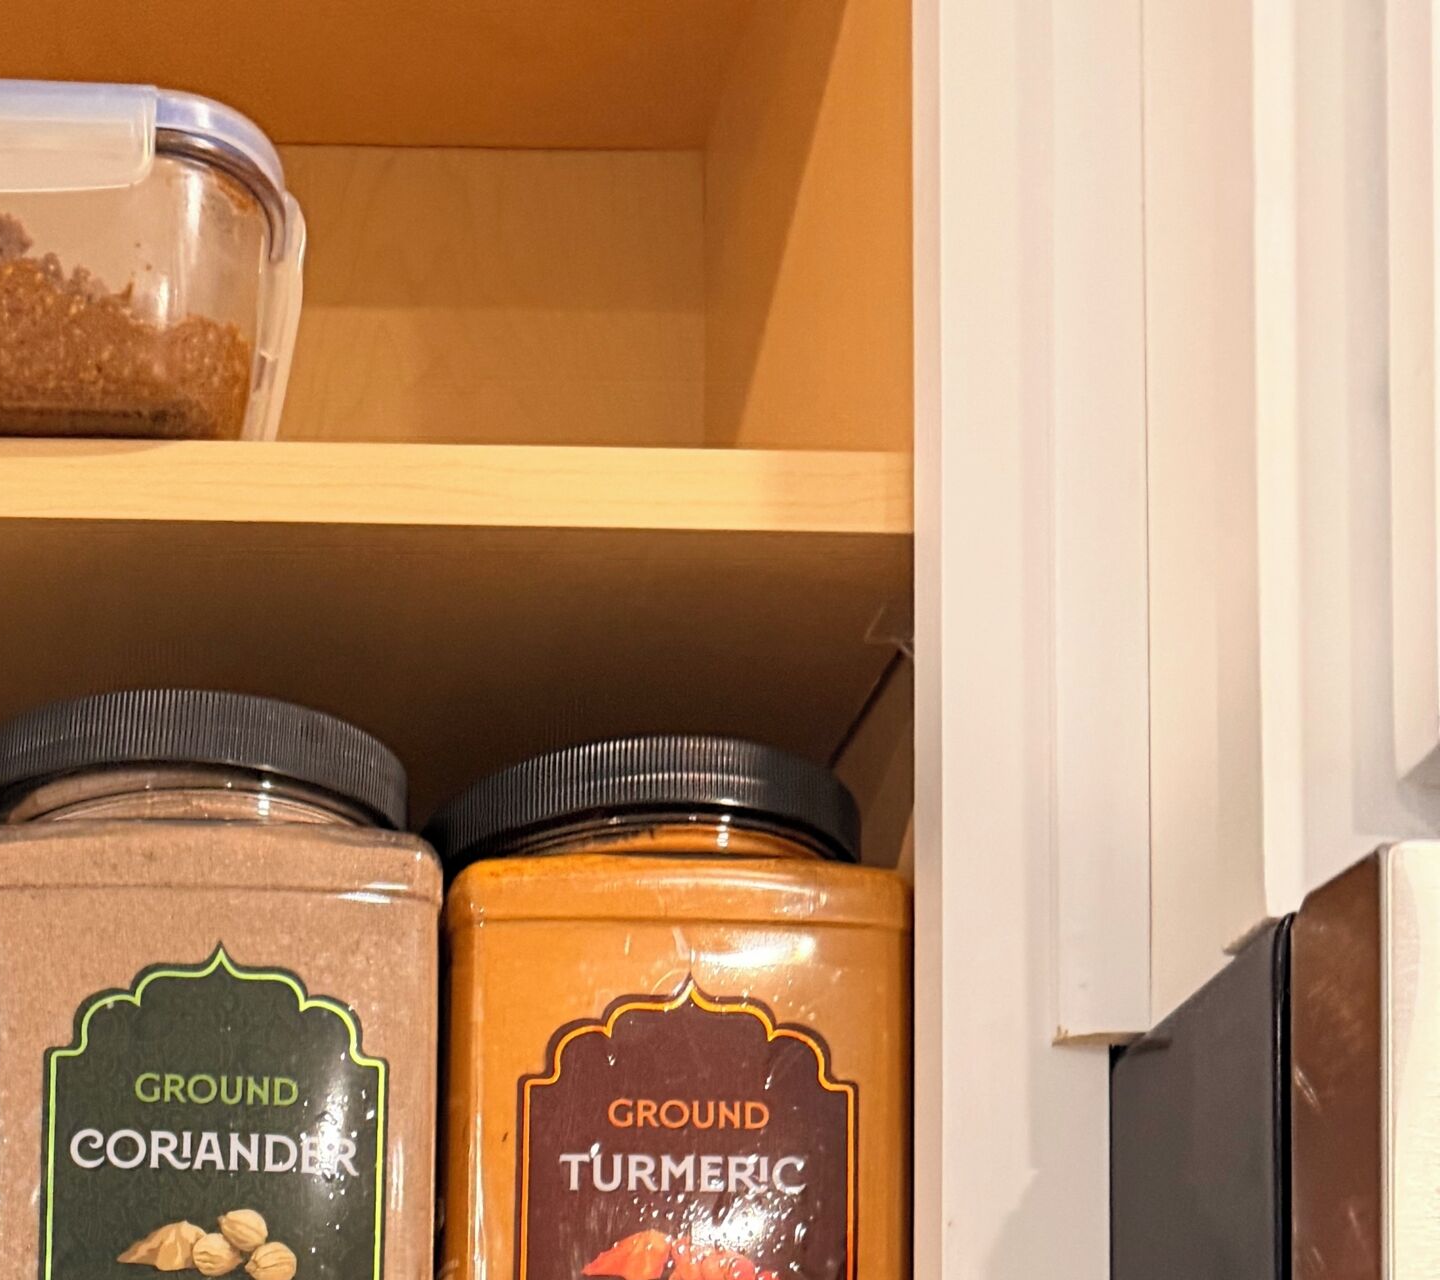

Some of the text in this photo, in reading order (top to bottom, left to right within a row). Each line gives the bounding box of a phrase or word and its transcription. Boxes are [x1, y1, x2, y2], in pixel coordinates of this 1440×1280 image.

[135, 1073, 298, 1105] GROUND
[608, 1099, 770, 1130] GROUND
[70, 1129, 359, 1176] CORIANDER
[559, 1152, 807, 1194] TURMERIC
